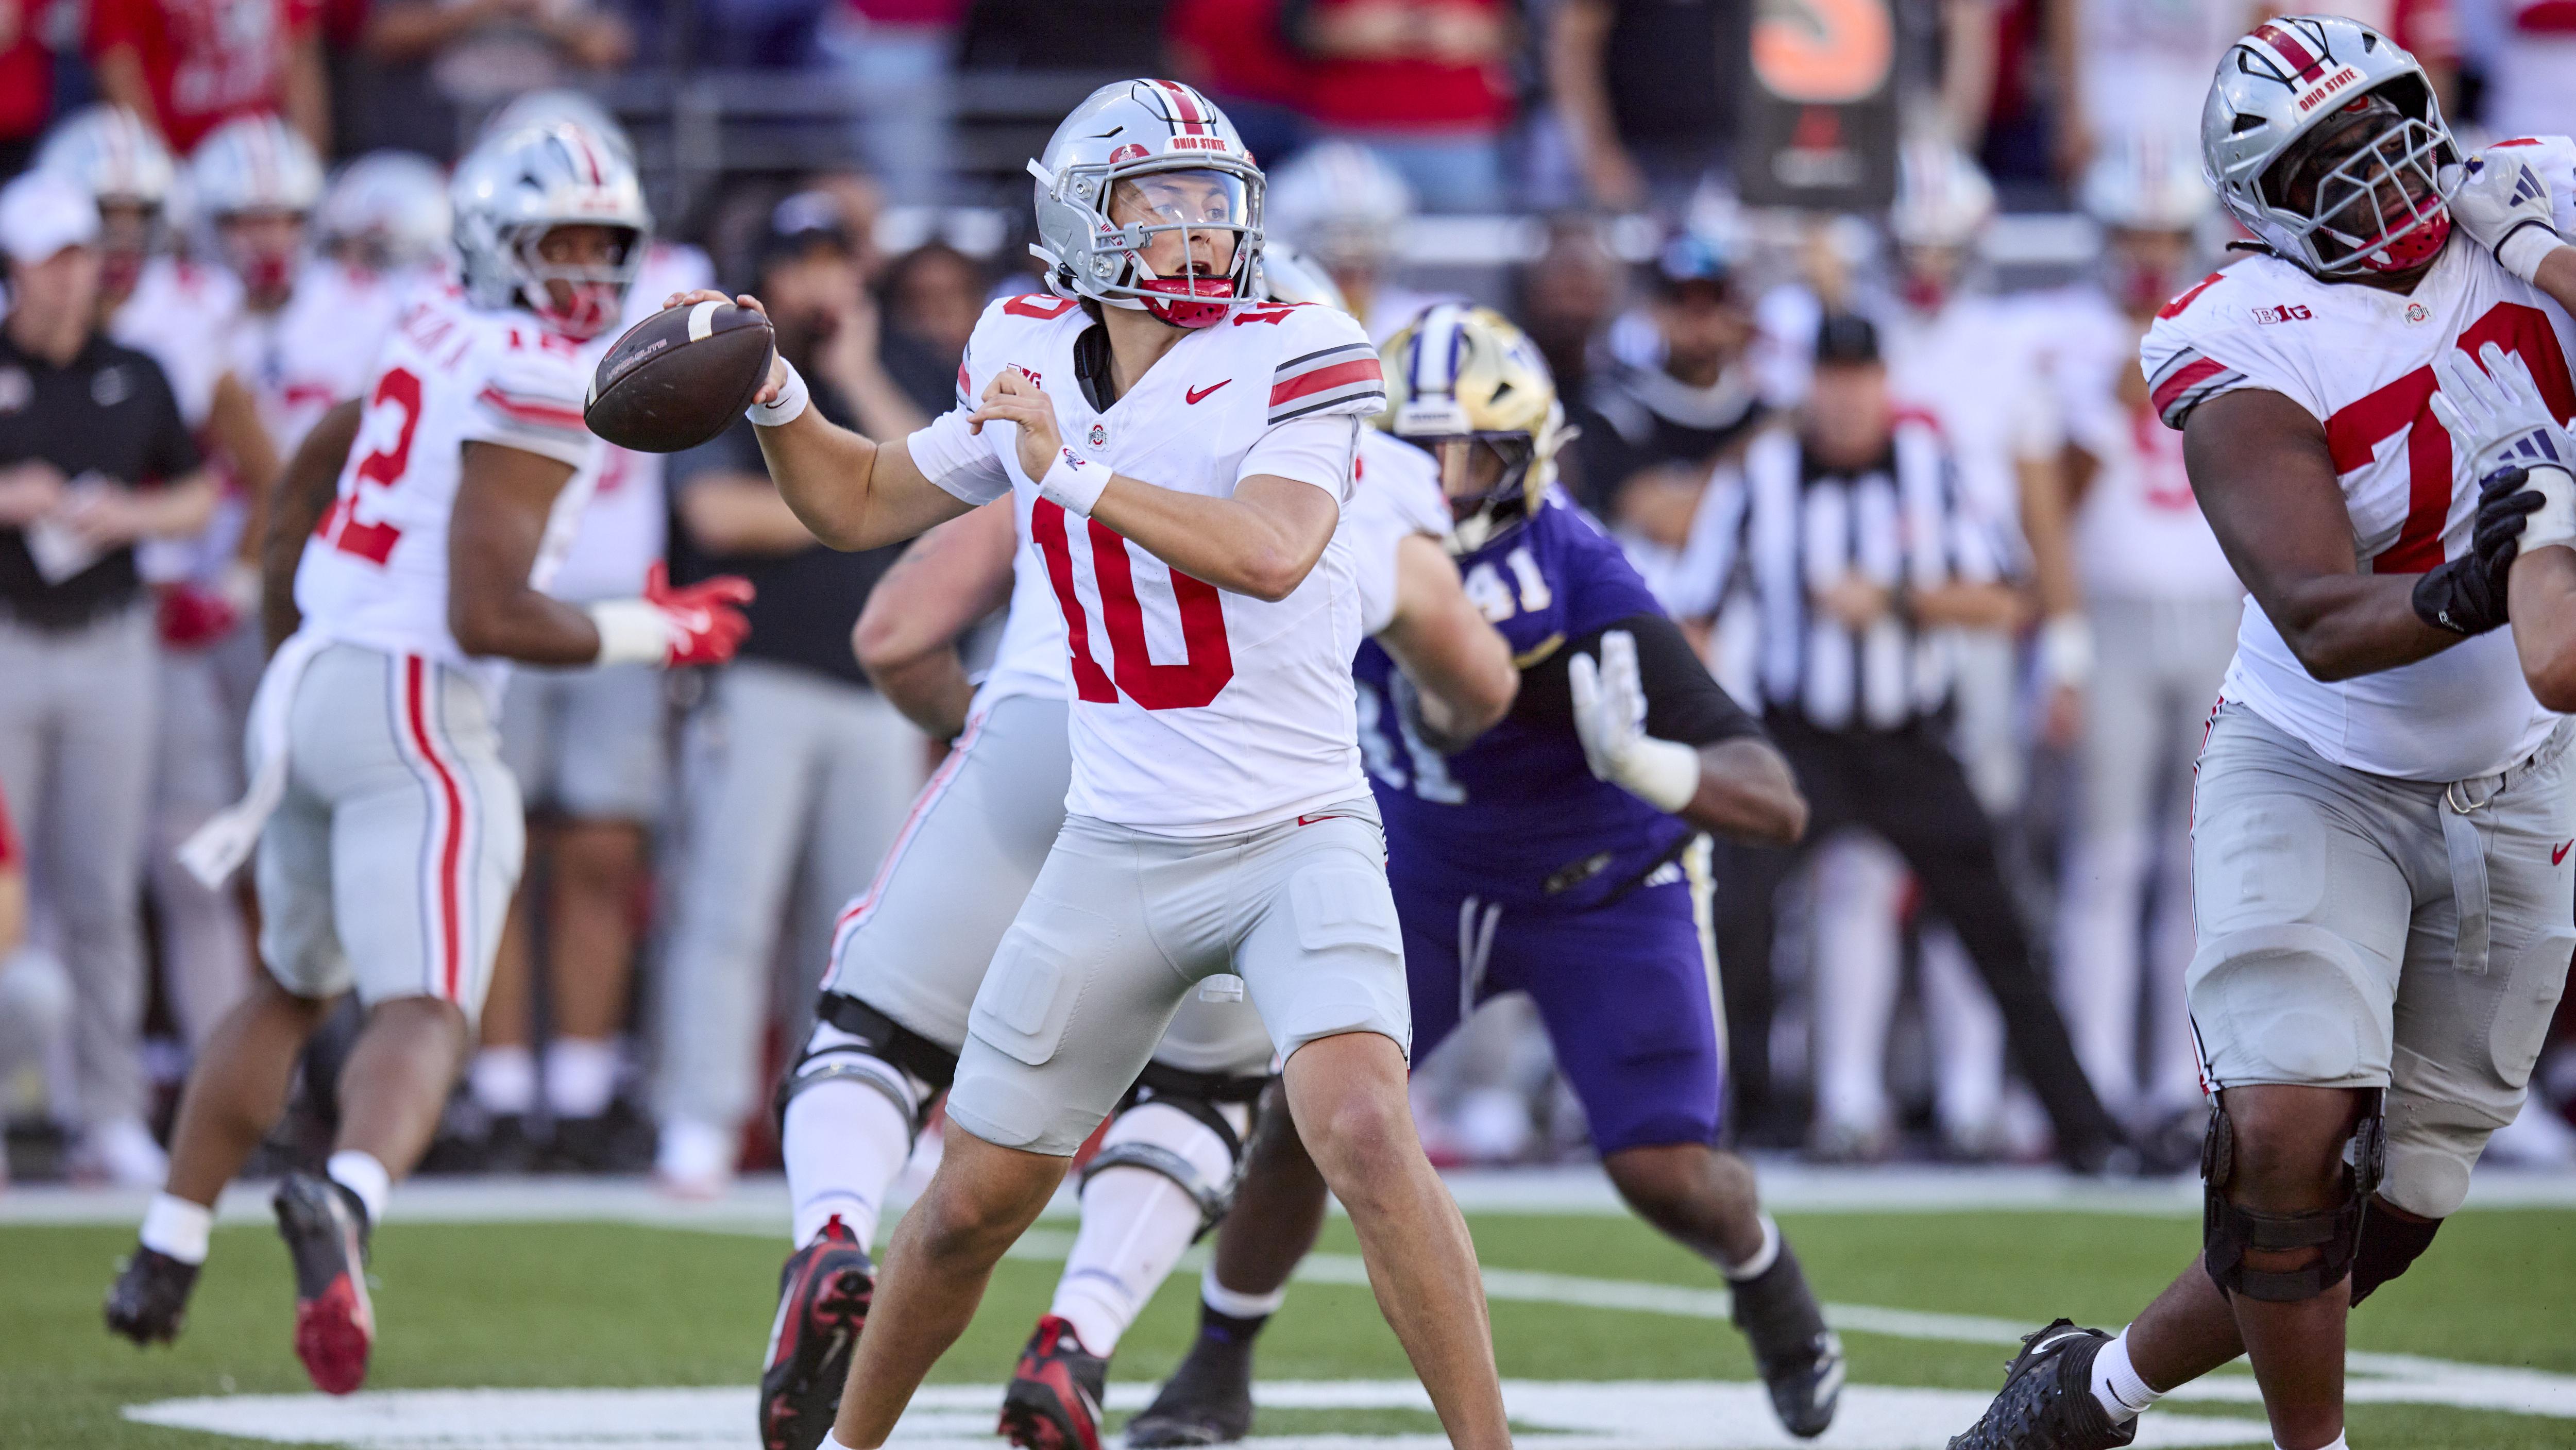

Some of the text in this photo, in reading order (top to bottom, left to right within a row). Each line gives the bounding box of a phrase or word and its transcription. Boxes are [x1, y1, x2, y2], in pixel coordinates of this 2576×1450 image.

[2299, 88, 2326, 111] OHIO
[2325, 68, 2357, 93] STATE
[1173, 138, 1226, 151] OHIO STATE
[1031, 495, 1234, 710] 10
